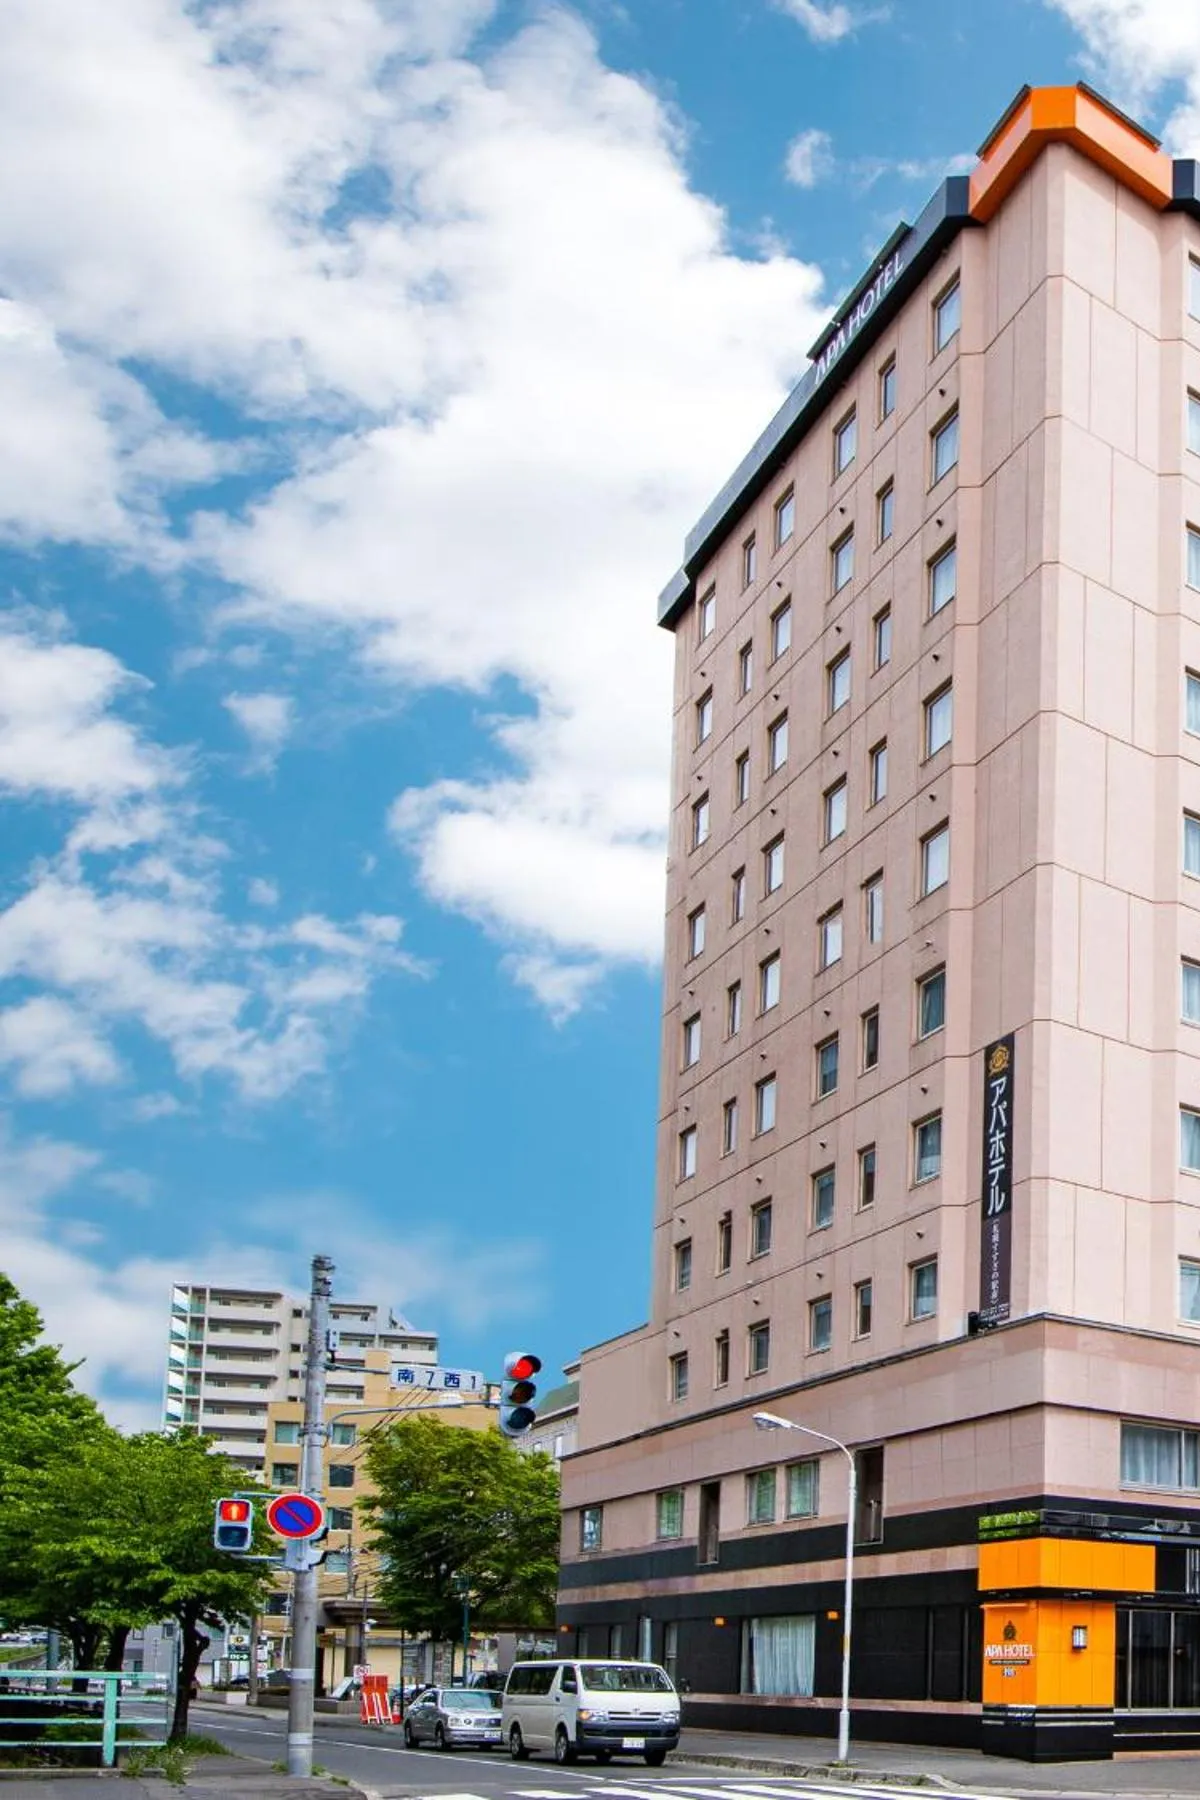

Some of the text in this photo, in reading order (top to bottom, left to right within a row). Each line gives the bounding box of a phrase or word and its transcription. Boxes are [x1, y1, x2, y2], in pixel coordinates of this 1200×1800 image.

[814, 251, 904, 386] APA HOTEL
[987, 1075, 1008, 1216] アパホテル
[1004, 1644, 1036, 1657] HOTEL
